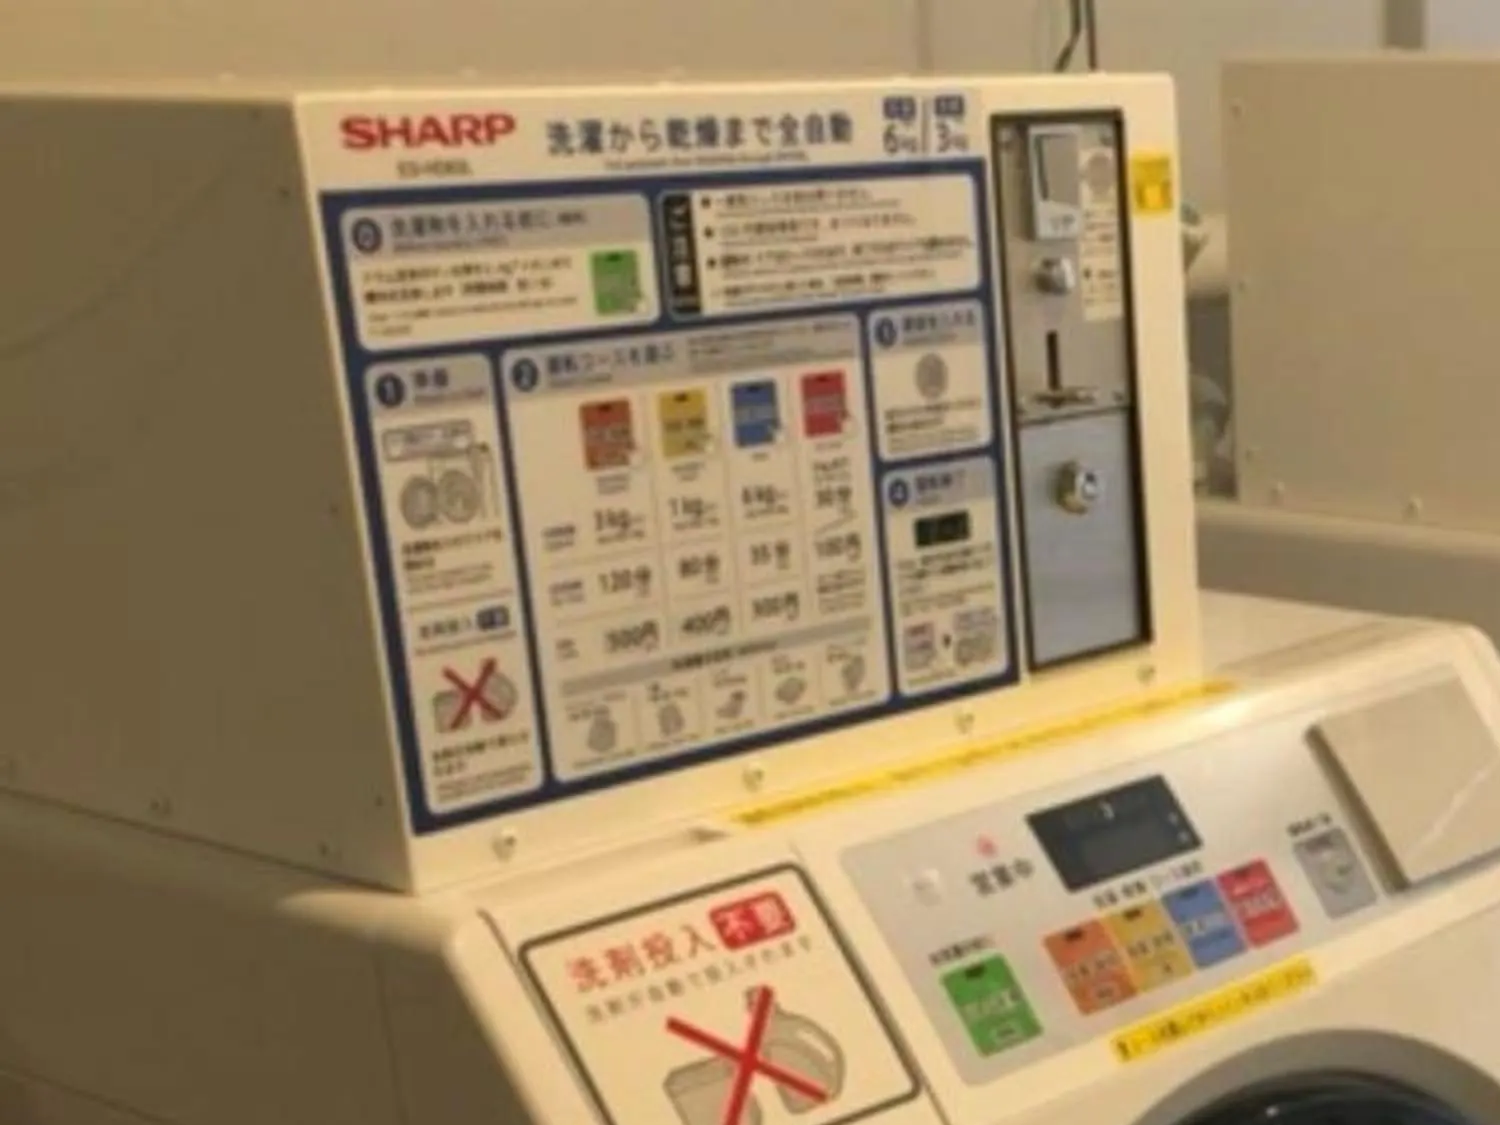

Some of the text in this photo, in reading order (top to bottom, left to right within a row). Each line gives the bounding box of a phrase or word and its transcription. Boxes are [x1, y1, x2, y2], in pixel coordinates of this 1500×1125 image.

[340, 112, 517, 151] SHARP
[546, 113, 853, 156] 洗濯から乾燥まで全自動
